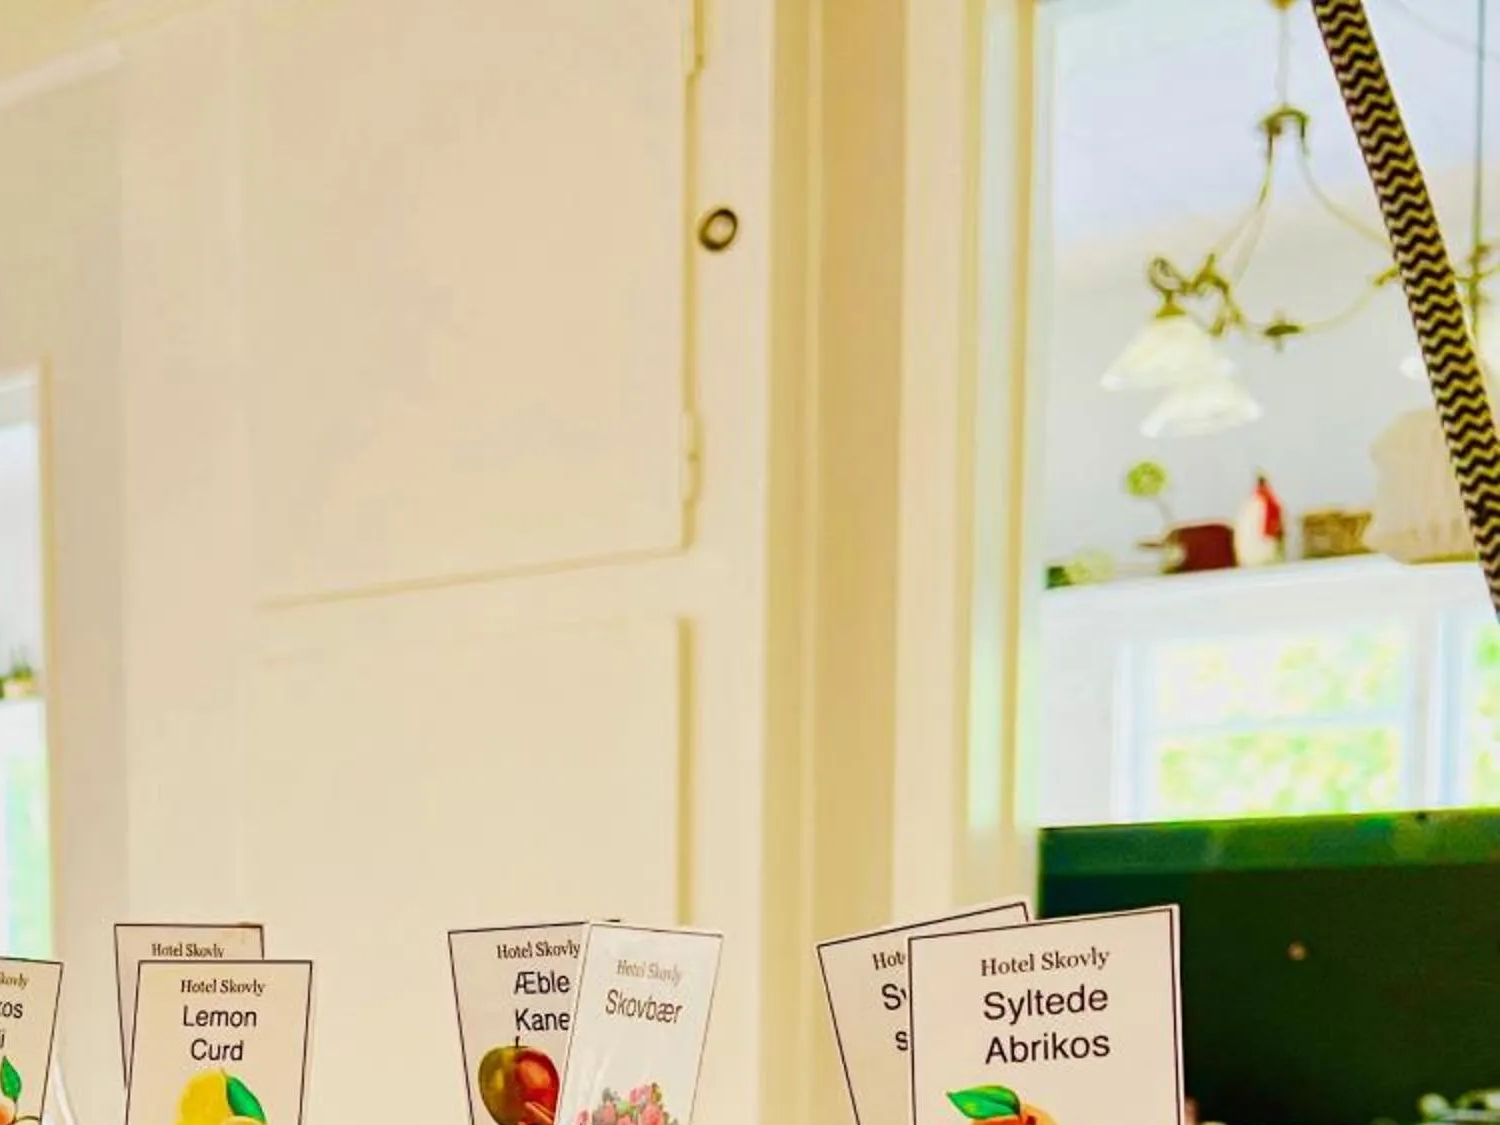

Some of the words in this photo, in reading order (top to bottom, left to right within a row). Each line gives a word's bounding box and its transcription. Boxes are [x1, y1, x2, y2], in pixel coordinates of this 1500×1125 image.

[151, 942, 183, 957] Hotel
[185, 943, 225, 958] Skovly
[497, 940, 532, 959] Hotel
[535, 939, 580, 959] Skovly
[981, 952, 1035, 977] Hotel
[1041, 946, 1110, 971] Skovly
[180, 978, 217, 994] Hotel
[219, 978, 266, 998] Skovly
[513, 969, 571, 995] Æble
[182, 1003, 258, 1028] Lemon
[605, 988, 684, 1024] Skovbær
[983, 983, 1109, 1026] Syltede
[190, 1037, 245, 1062] Curd
[985, 1031, 1112, 1065] Abrikos
